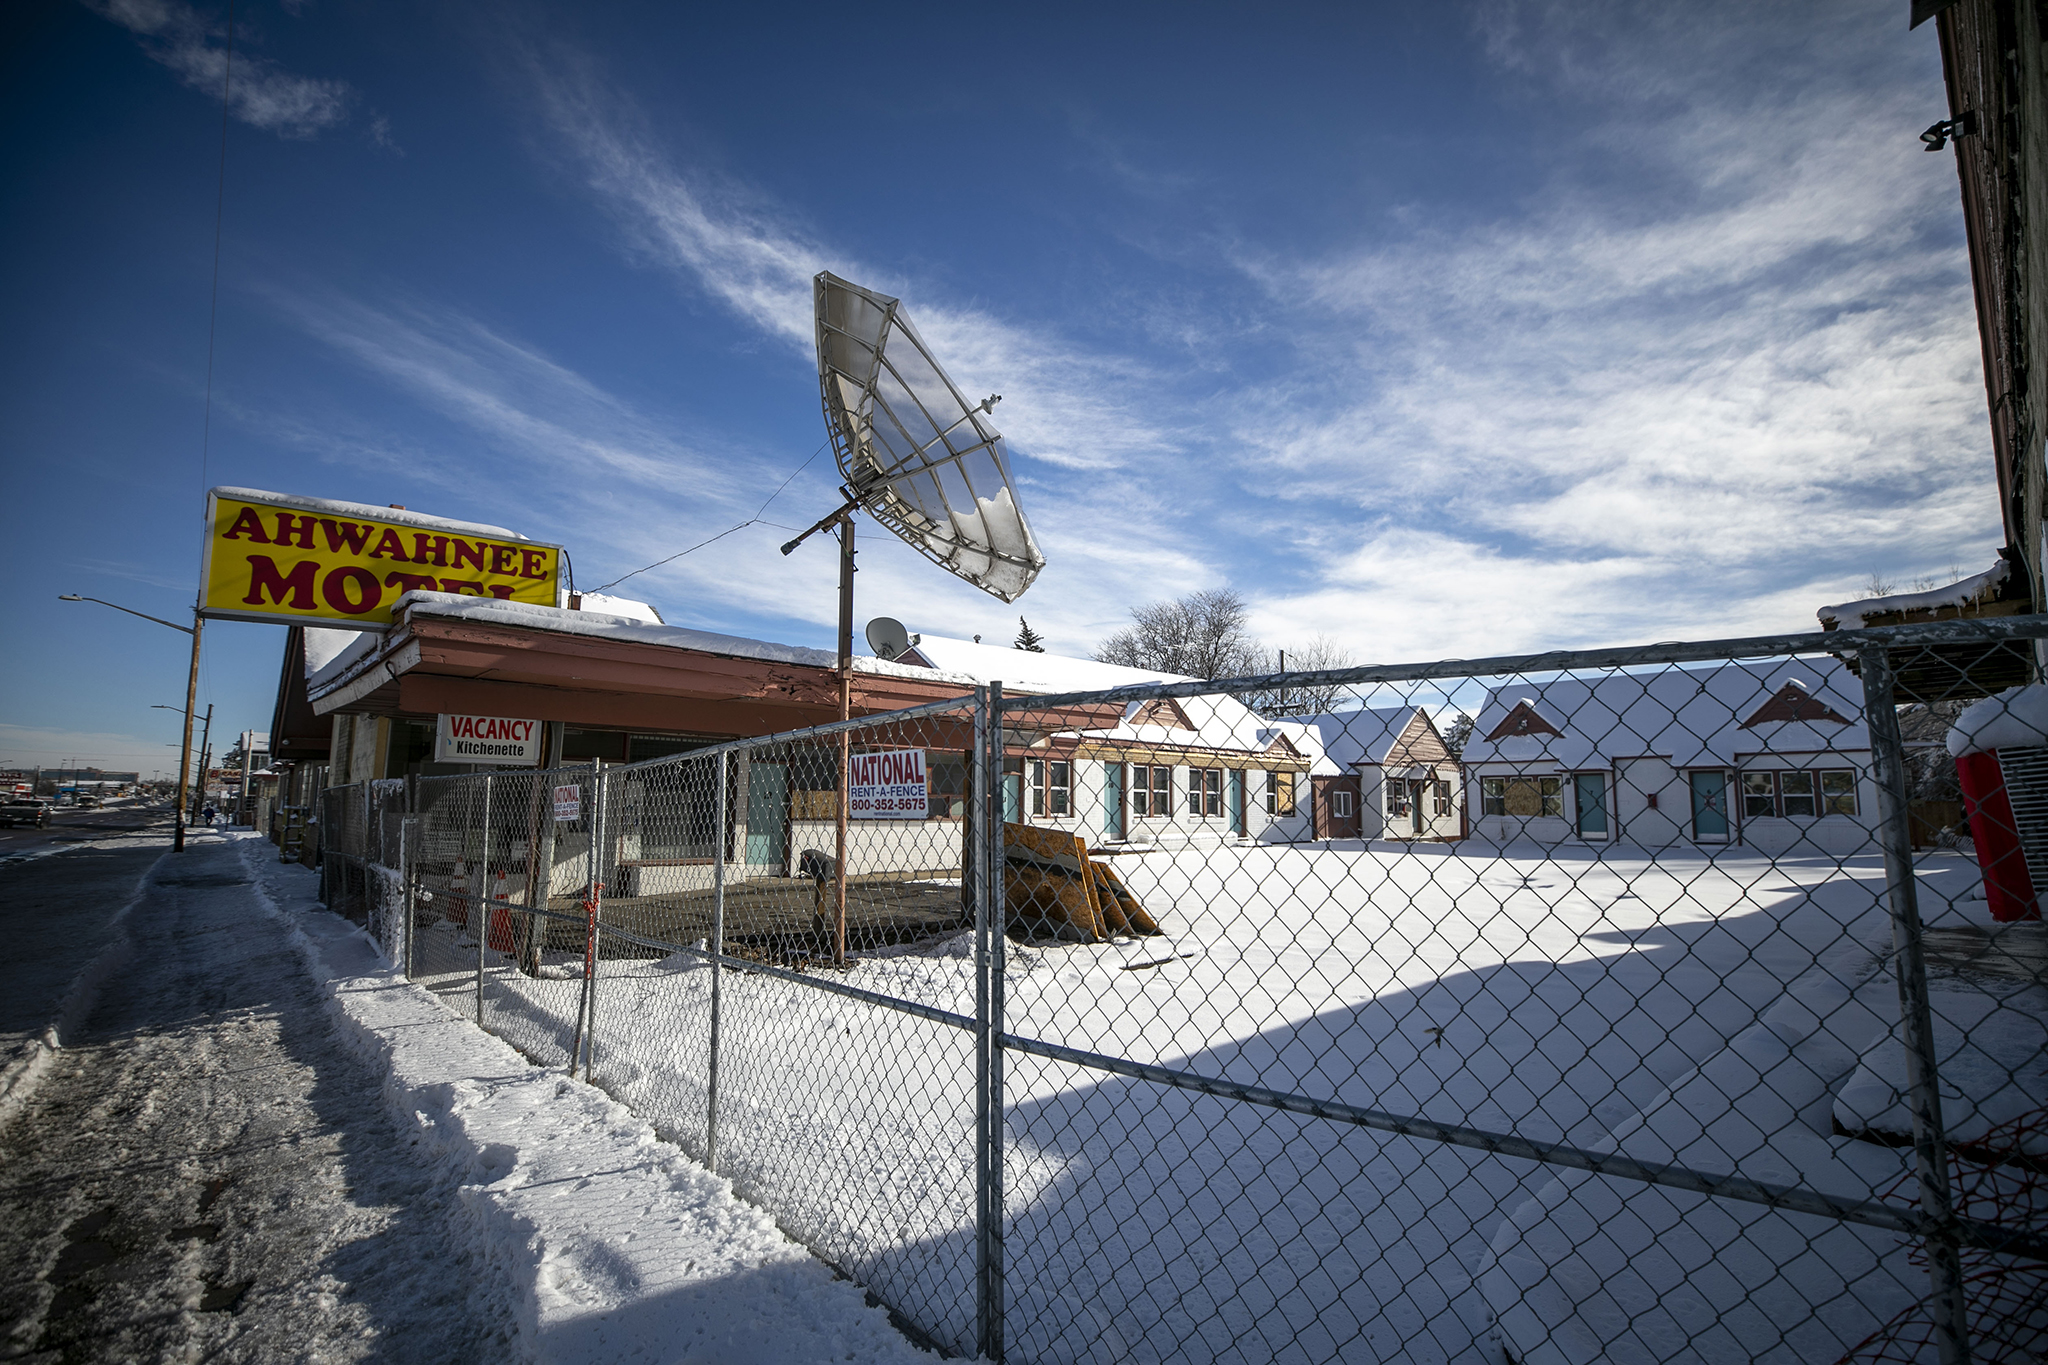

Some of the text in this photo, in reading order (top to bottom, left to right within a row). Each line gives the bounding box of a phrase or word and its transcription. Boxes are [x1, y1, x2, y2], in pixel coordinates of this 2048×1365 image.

[222, 506, 548, 581] AHWAHNEE
[242, 555, 516, 615] MOT
[450, 716, 534, 742] VACANCY
[456, 741, 524, 757] Kitchenette
[851, 752, 925, 786] NATIONAL
[851, 785, 926, 797] RENT-A-FENCE
[851, 798, 926, 811] 800-352-5675
